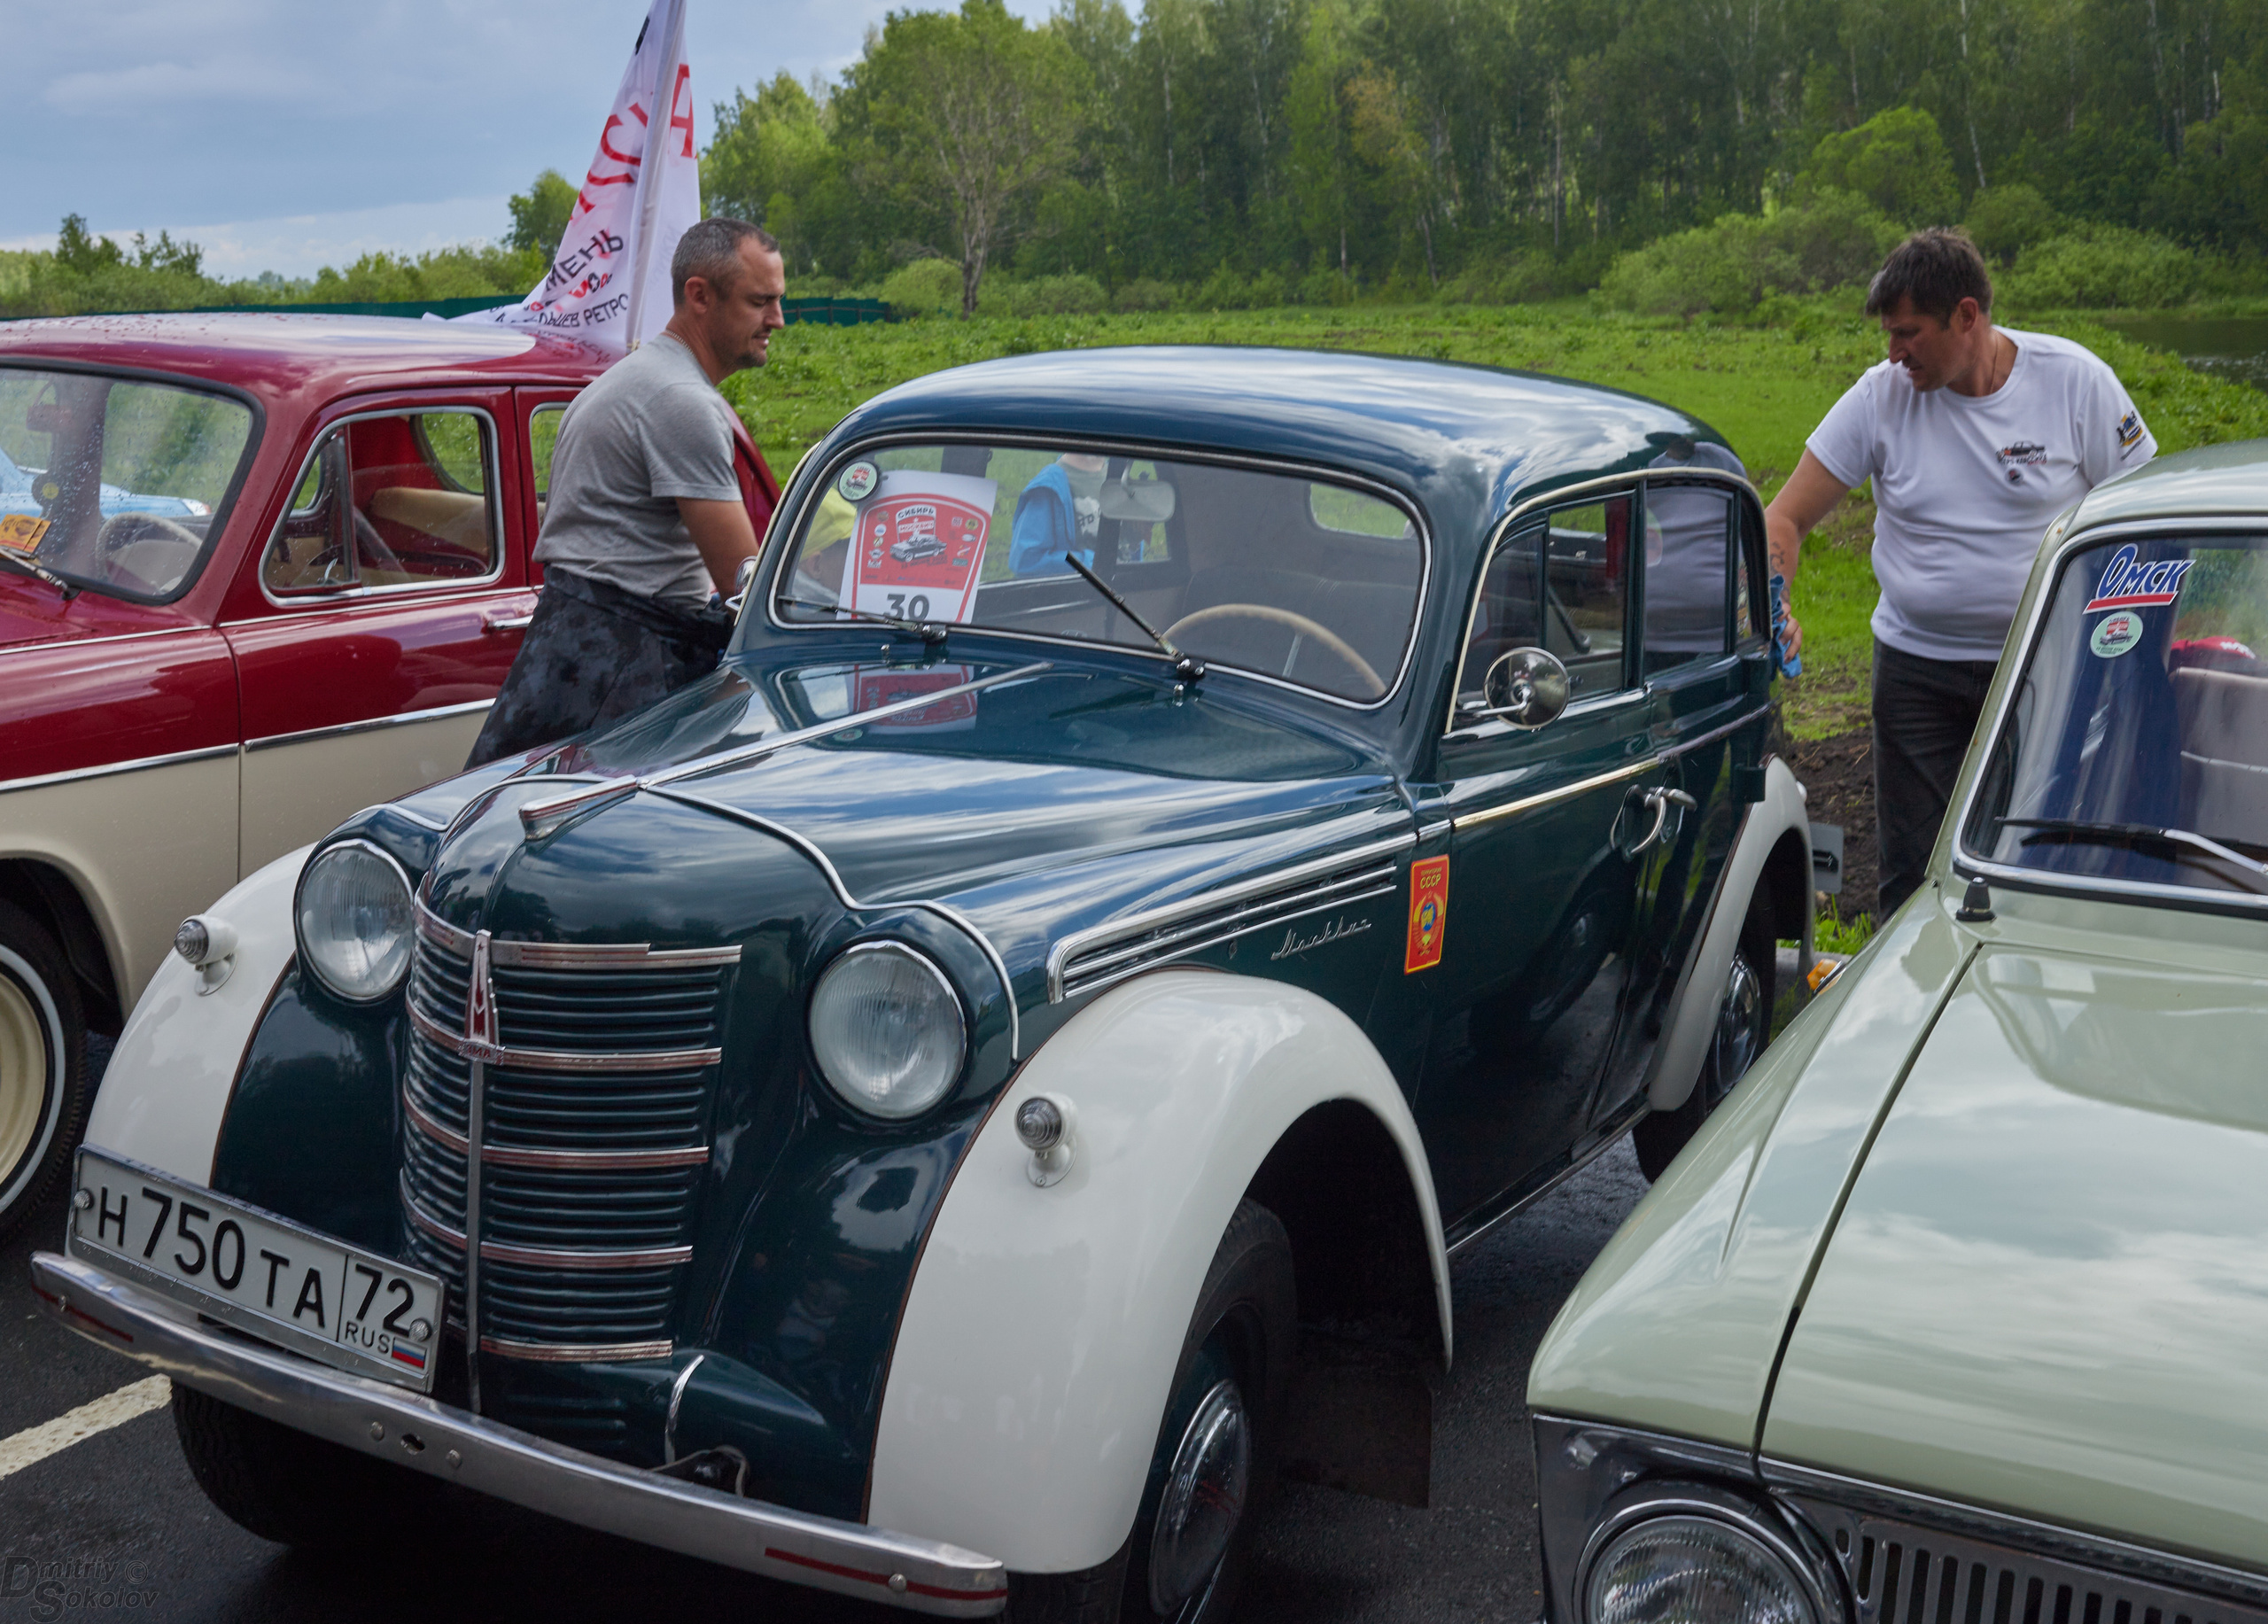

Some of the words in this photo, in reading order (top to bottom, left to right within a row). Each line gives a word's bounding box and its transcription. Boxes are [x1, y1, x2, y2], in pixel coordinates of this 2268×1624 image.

[897, 506, 934, 518] СИБИРЬ
[886, 594, 930, 620] 30
[1420, 873, 1441, 890] СССР
[354, 1263, 416, 1339] 72
[345, 1320, 391, 1355] RUS
